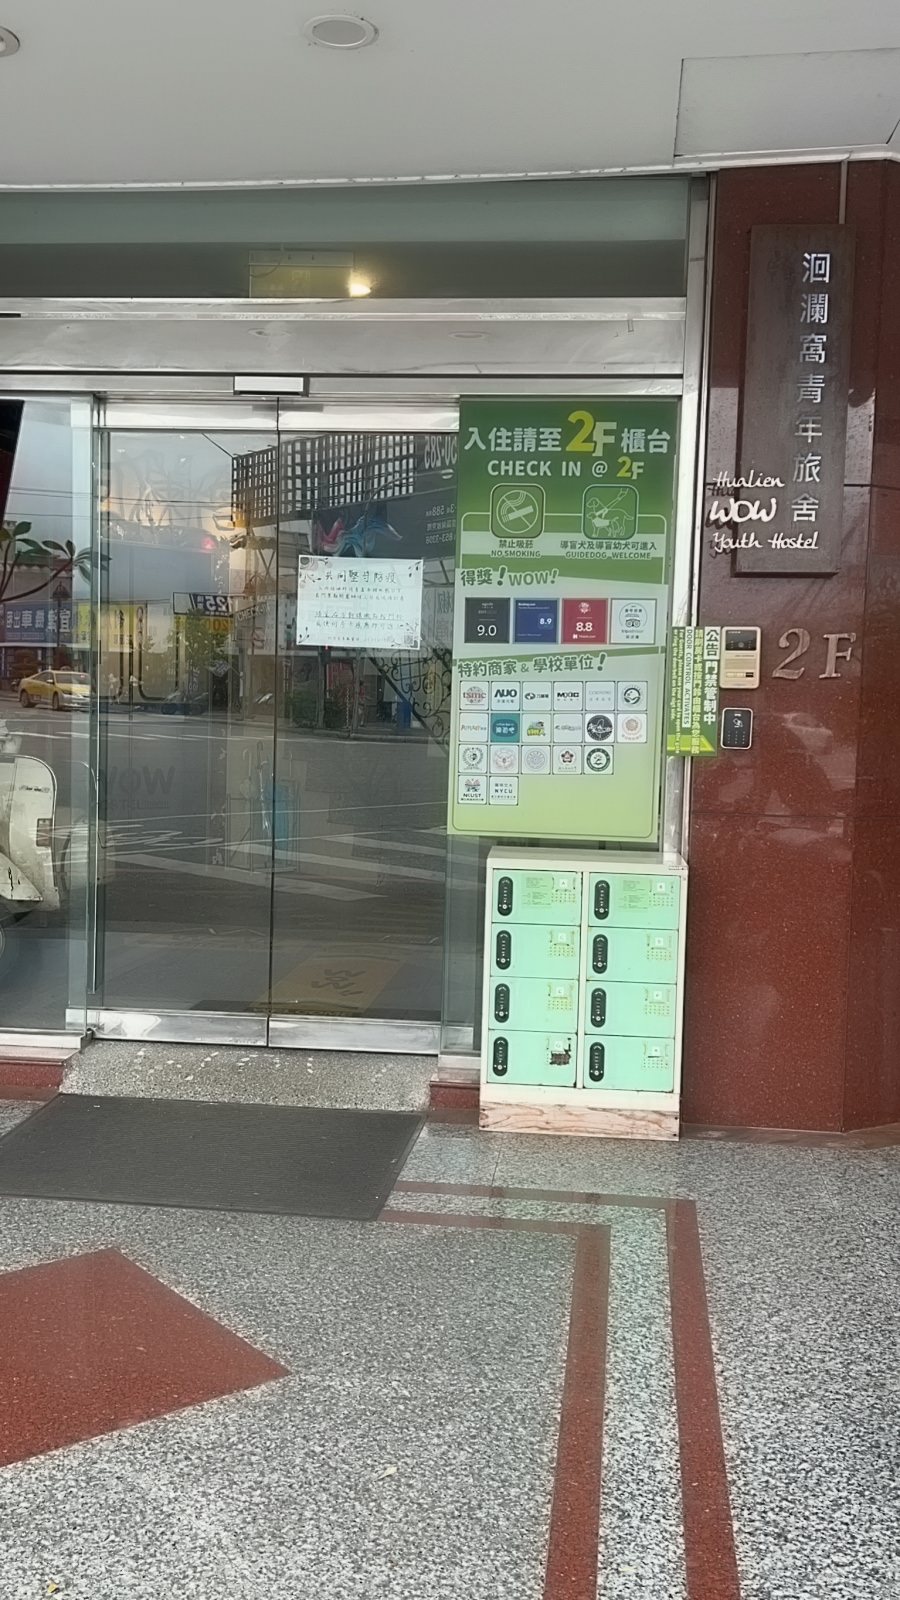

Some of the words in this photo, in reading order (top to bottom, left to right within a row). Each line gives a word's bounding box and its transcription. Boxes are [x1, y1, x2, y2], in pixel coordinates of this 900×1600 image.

[790, 252, 831, 522] 洄瀾窩青年旅舍
[487, 459, 552, 477] CHECK
[561, 461, 581, 477] IN
[591, 460, 608, 478] @
[616, 456, 645, 480] 2F
[713, 469, 786, 488] Hualien
[709, 497, 778, 523] WOW
[498, 539, 534, 549] 禁止吸菸
[560, 540, 657, 551] 導盲犬及導盲幼犬可進入
[713, 531, 763, 553] Youth
[767, 531, 819, 549] Hostel
[504, 550, 541, 558] SMOKING
[565, 551, 607, 559] GUIDEDOG
[611, 552, 652, 560] WELCOME
[477, 624, 497, 637] 9.0
[539, 618, 553, 626] 8.9
[576, 622, 593, 632] 8.8
[706, 629, 719, 657] 公告
[772, 628, 857, 680] 2F
[458, 660, 517, 678] 特約商家
[520, 663, 530, 673] &
[684, 652, 692, 685] CONTROL
[463, 691, 487, 699] tsmc
[494, 688, 518, 698] AUO
[703, 661, 718, 725] 門禁管制中
[683, 688, 691, 725] ACTIVATES
